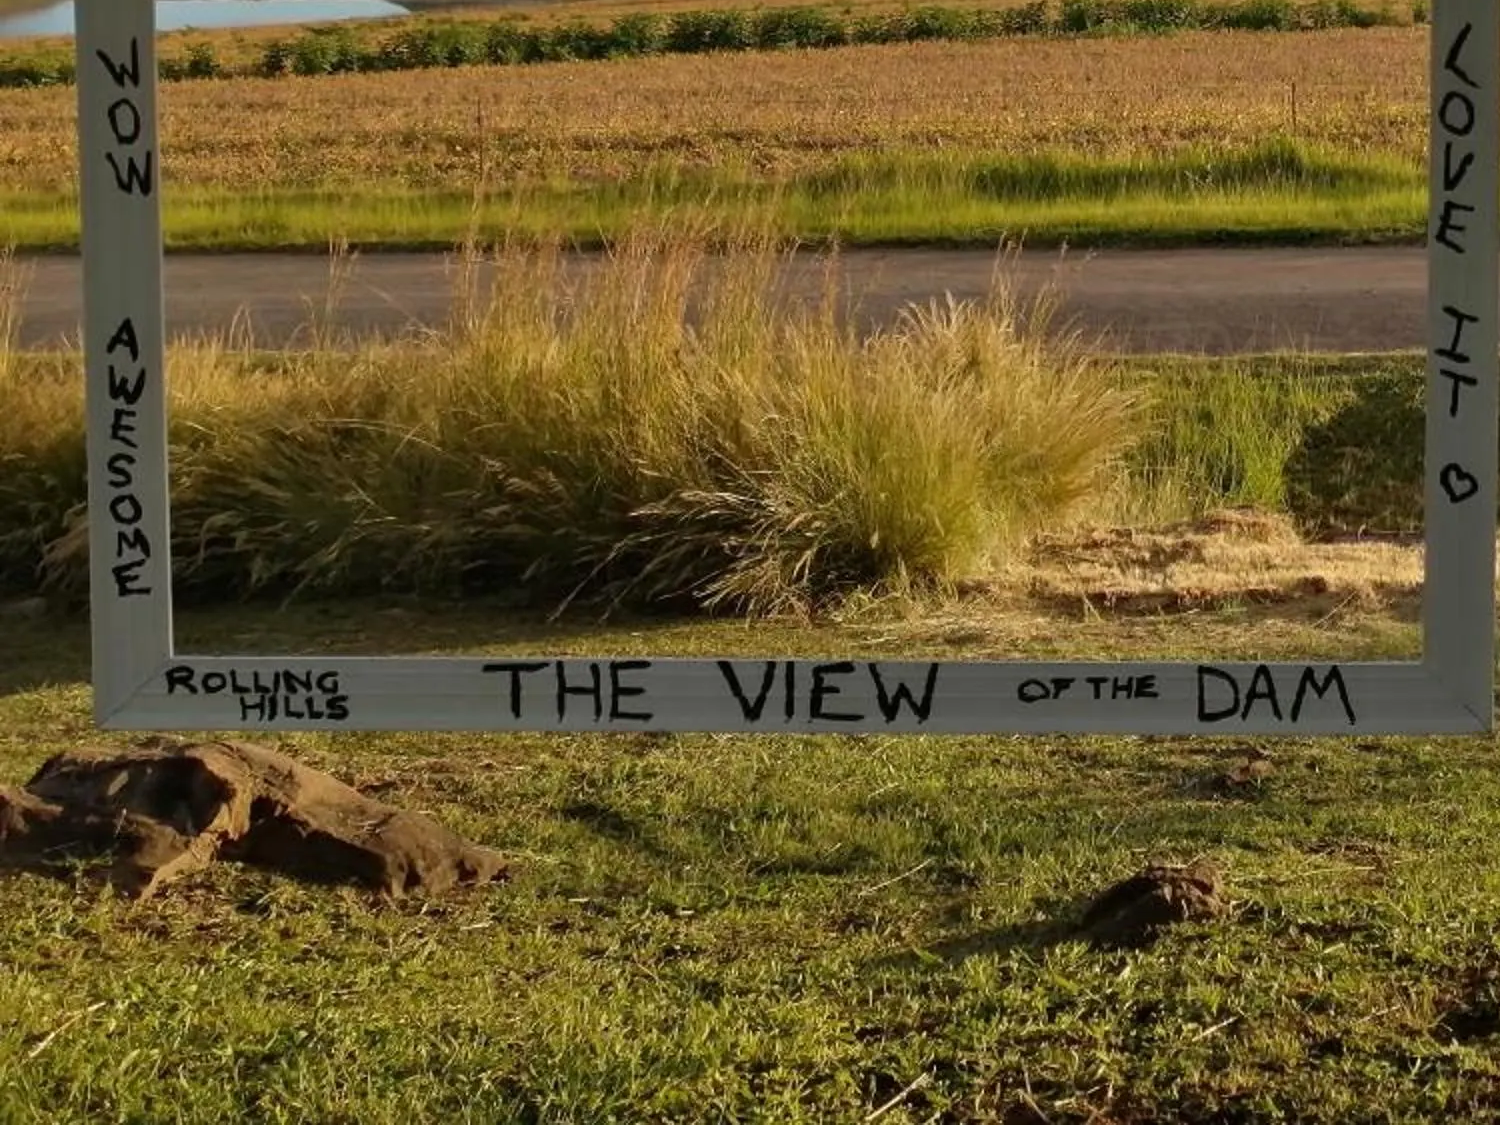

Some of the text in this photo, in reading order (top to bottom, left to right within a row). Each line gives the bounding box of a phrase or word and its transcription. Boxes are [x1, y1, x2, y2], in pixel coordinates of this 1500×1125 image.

[1435, 24, 1482, 417] LOVE IT
[96, 36, 153, 597] WOW AWESOME
[165, 665, 339, 695] ROLLING
[239, 694, 350, 722] HILLS
[482, 660, 1356, 725] THE VIEW OF THE DAM
